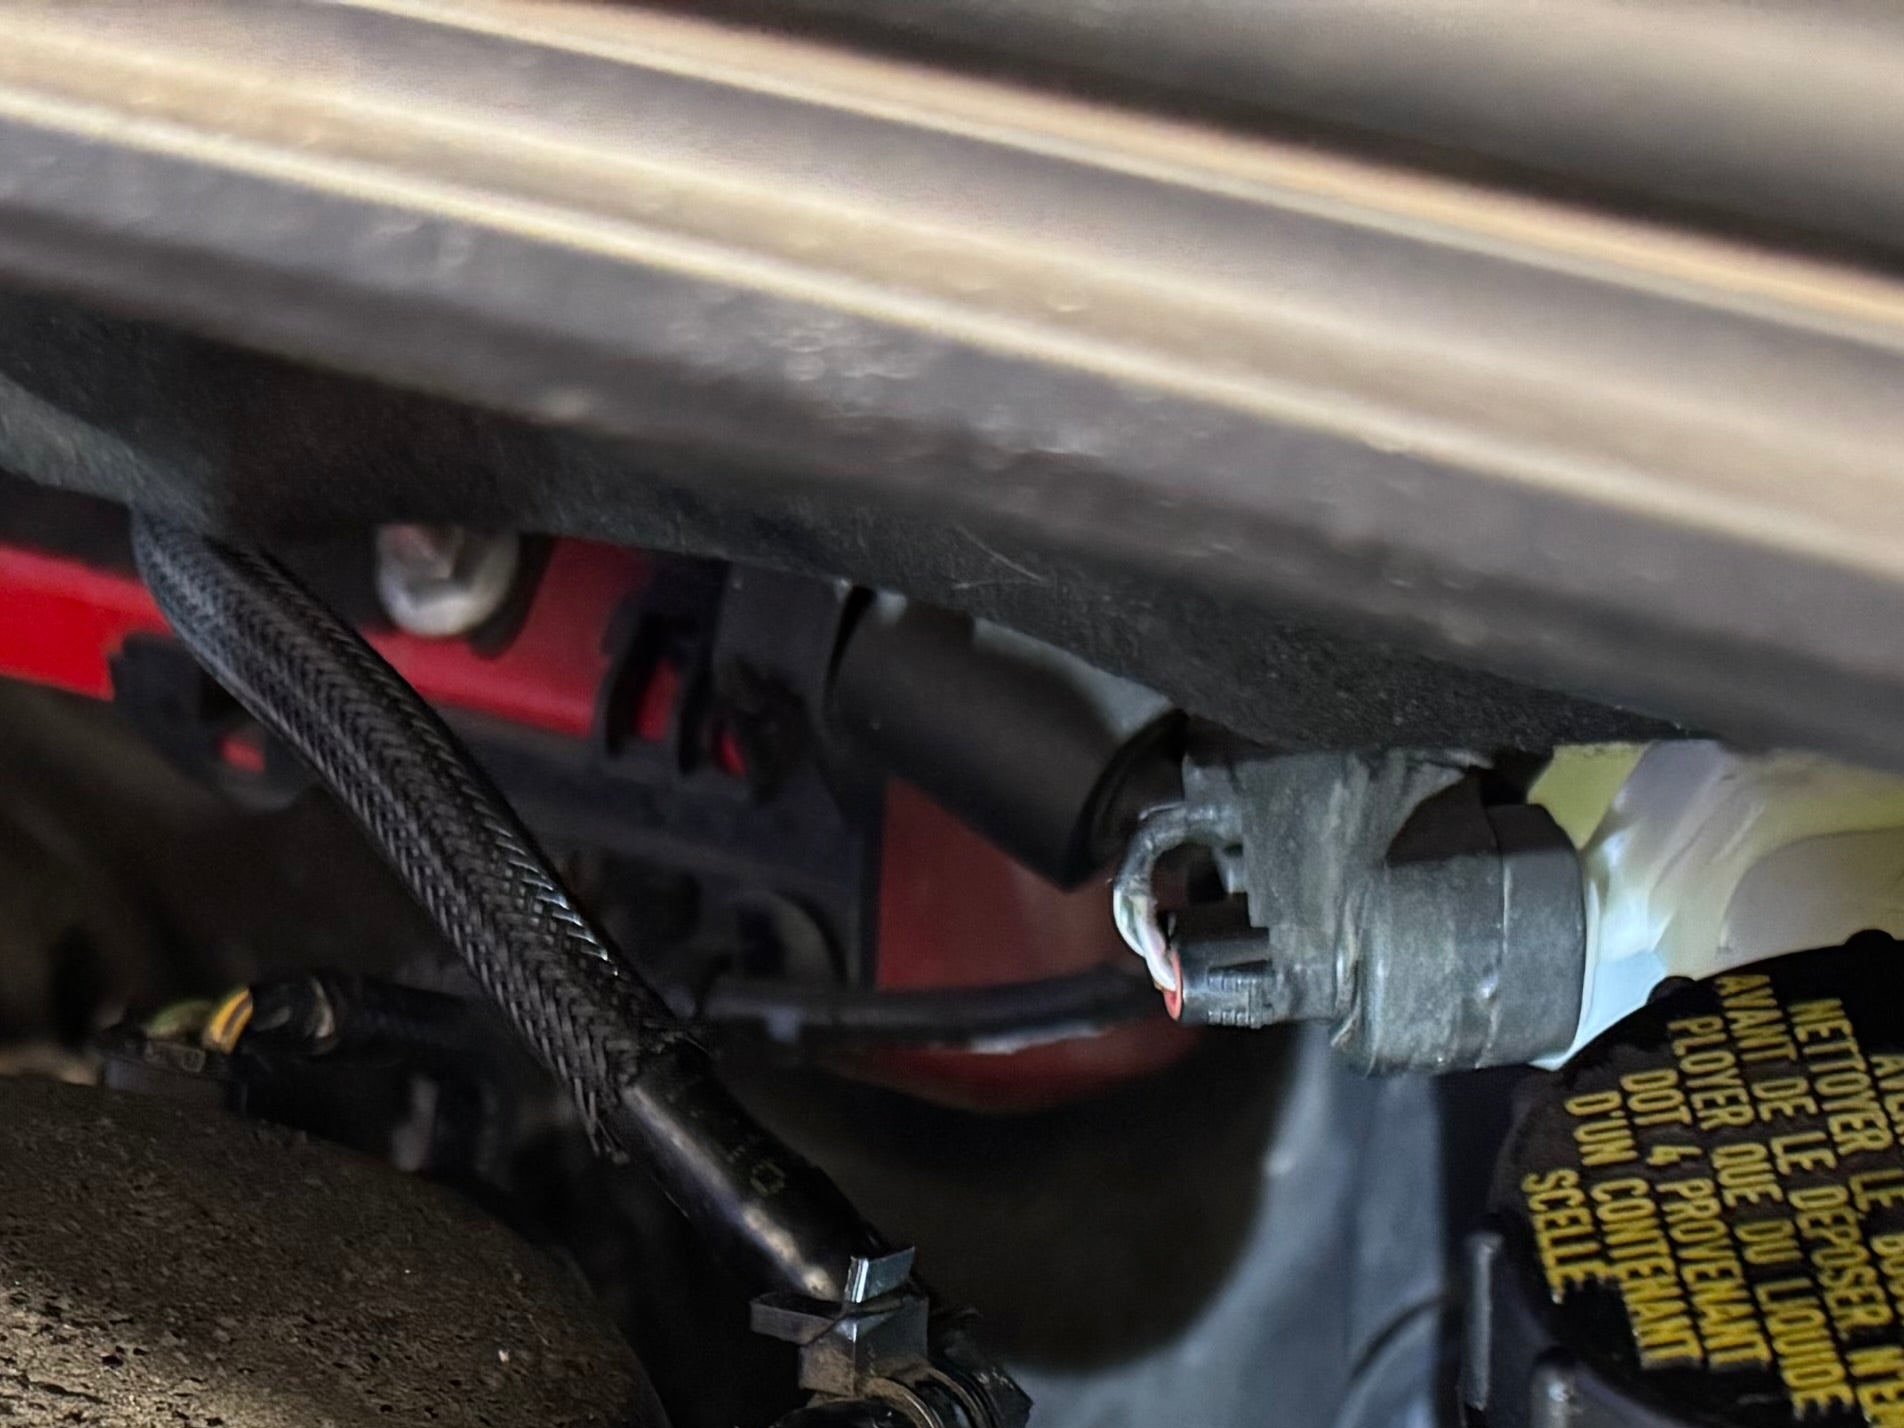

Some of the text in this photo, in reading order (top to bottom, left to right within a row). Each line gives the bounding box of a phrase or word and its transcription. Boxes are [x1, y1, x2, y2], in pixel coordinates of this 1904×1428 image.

[1714, 974, 1798, 1062] AVANT
[1787, 998, 1893, 1156] NETTOYER
[1752, 1077, 1818, 1121] DE
[1770, 1131, 1837, 1175] LE
[1565, 1090, 1702, 1369] D'UN CONTENANT
[1621, 1069, 1771, 1369] DOT 4 PROVENANT
[1668, 1016, 1856, 1420] PLOYER QUE DU LIQUIDE
